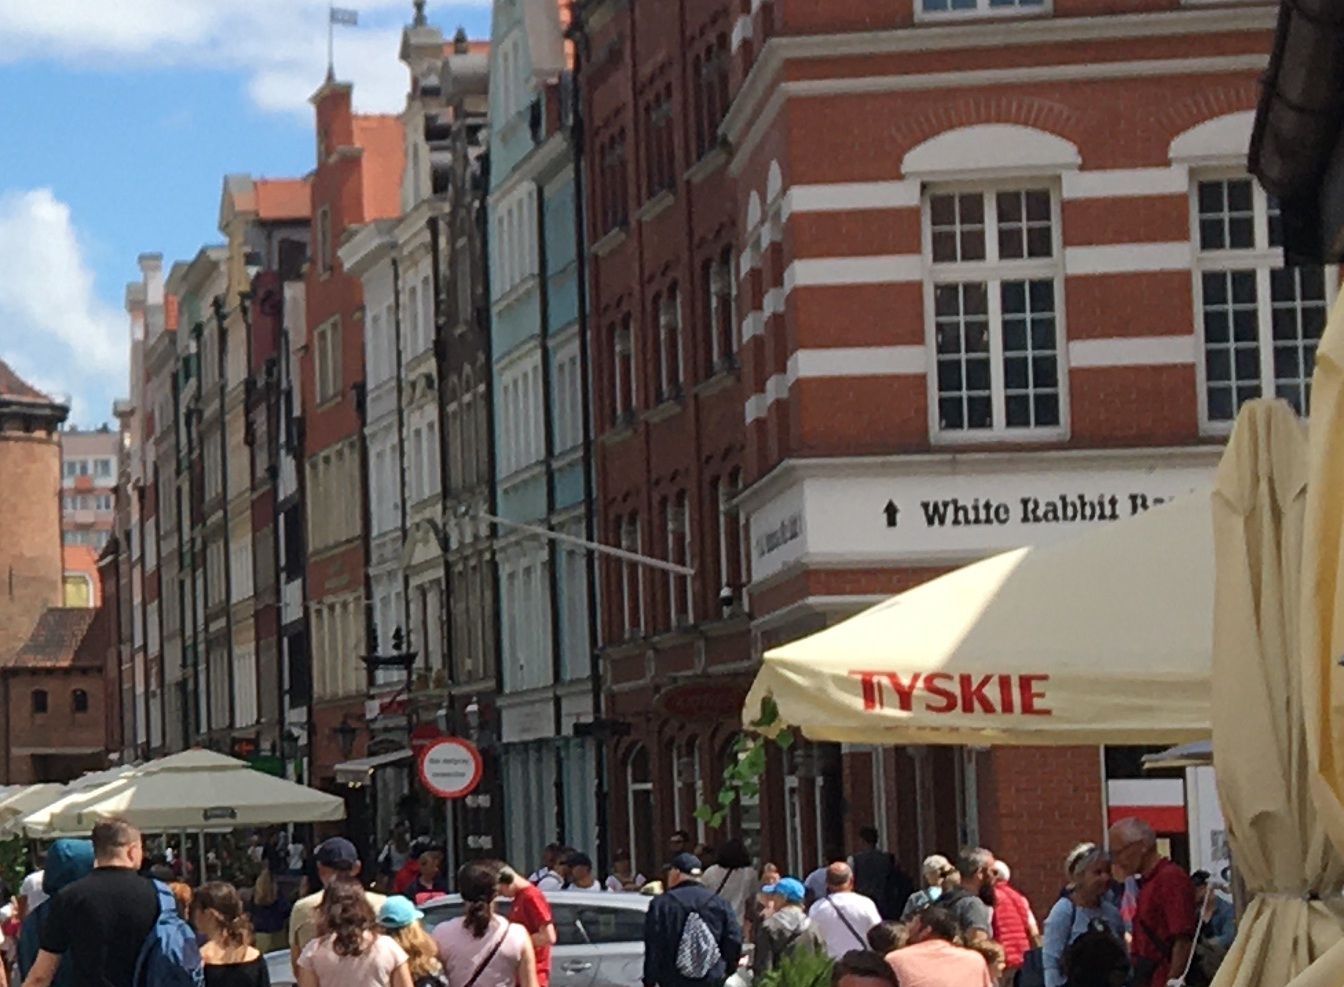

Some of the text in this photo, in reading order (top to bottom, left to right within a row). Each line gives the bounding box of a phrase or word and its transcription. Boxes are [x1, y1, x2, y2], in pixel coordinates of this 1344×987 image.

[921, 497, 1010, 527] White
[1020, 493, 1120, 523] Rabbit
[848, 669, 1053, 716] TYSKIE
